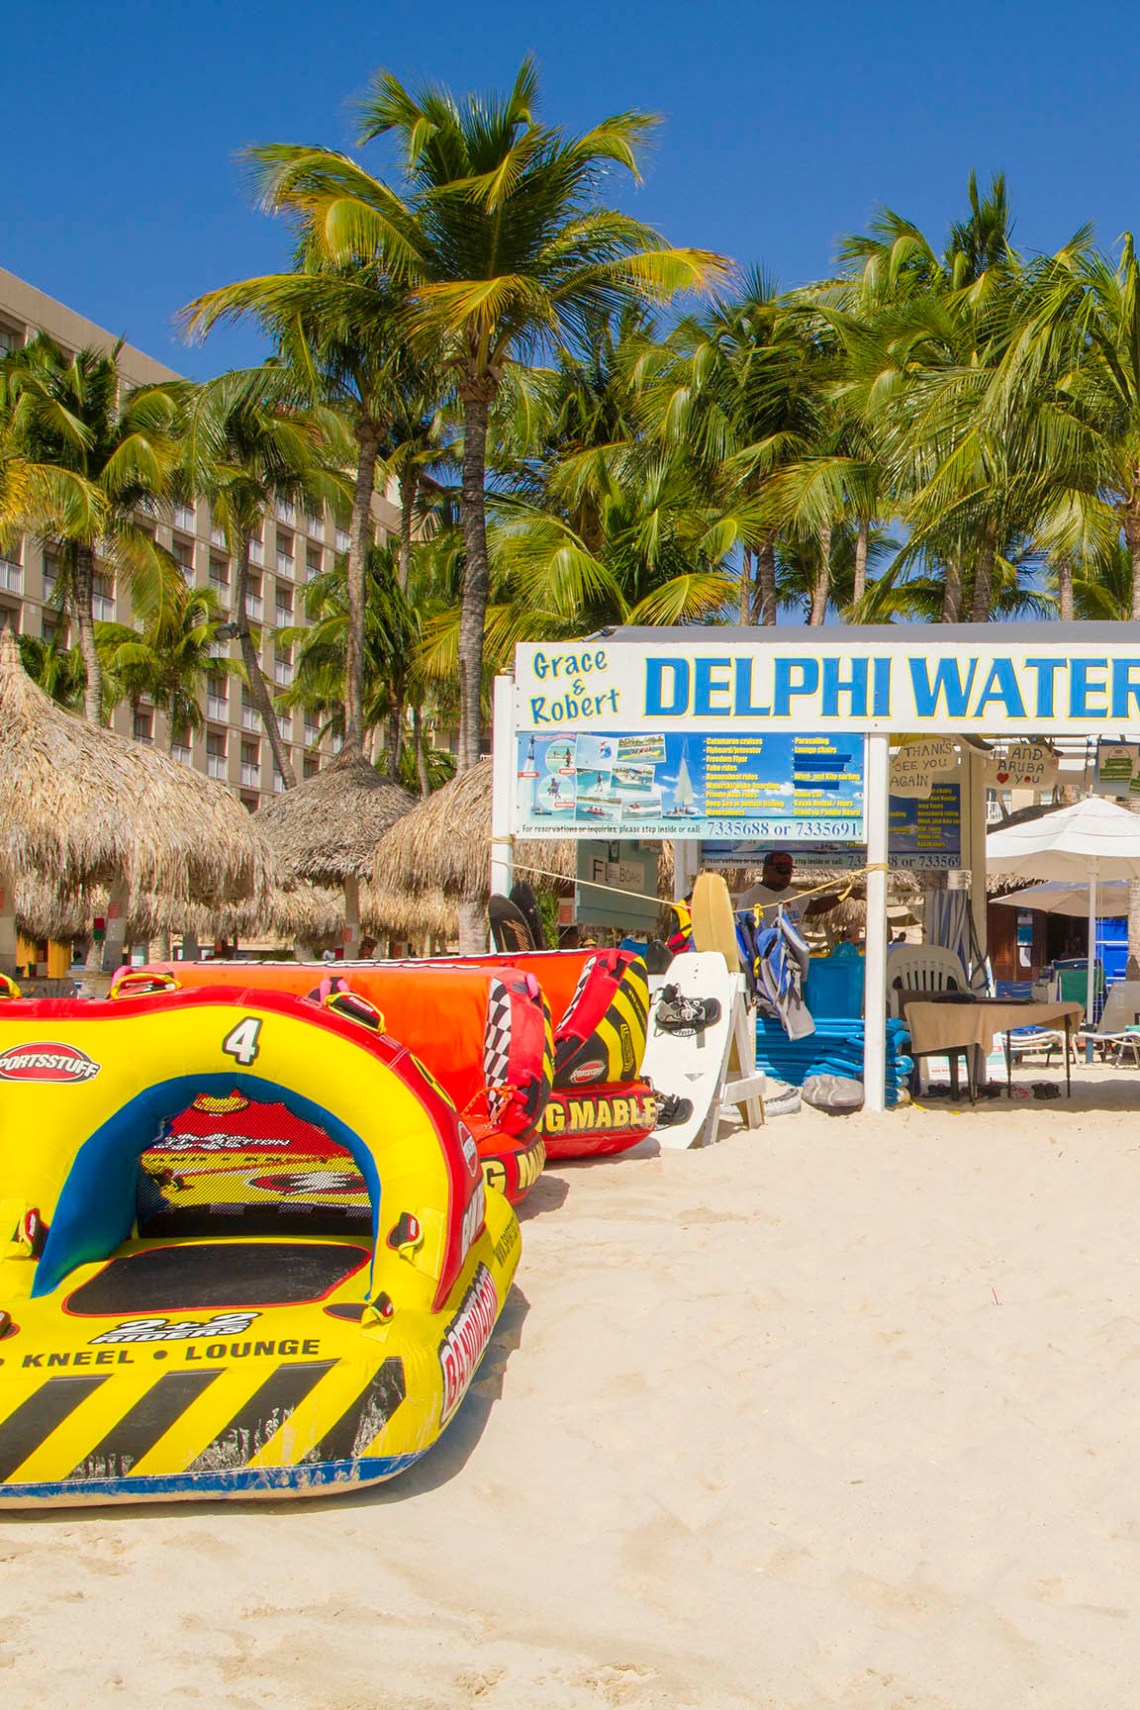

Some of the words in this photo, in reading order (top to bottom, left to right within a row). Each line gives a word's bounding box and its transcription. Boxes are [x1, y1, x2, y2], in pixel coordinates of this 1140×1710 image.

[533, 649, 608, 680] Grace
[572, 679, 586, 696] &
[644, 656, 892, 718] DELPHI
[530, 688, 621, 726] Robert
[904, 742, 952, 757] THANKS
[1012, 747, 1043, 761] AND
[998, 760, 1045, 774] ARUBA
[889, 774, 929, 788] AGAIN
[522, 825, 534, 833] For
[534, 825, 577, 834] reservations
[619, 825, 640, 835] please
[641, 825, 656, 835] step
[657, 825, 677, 834] inside
[707, 822, 769, 837] 7335688
[774, 824, 792, 837] or
[901, 858, 915, 867] or
[223, 1016, 262, 1065] 4
[569, 1096, 658, 1132] MABLE
[21, 1350, 136, 1368] KNEEL
[184, 1339, 320, 1361] LOUNGE
